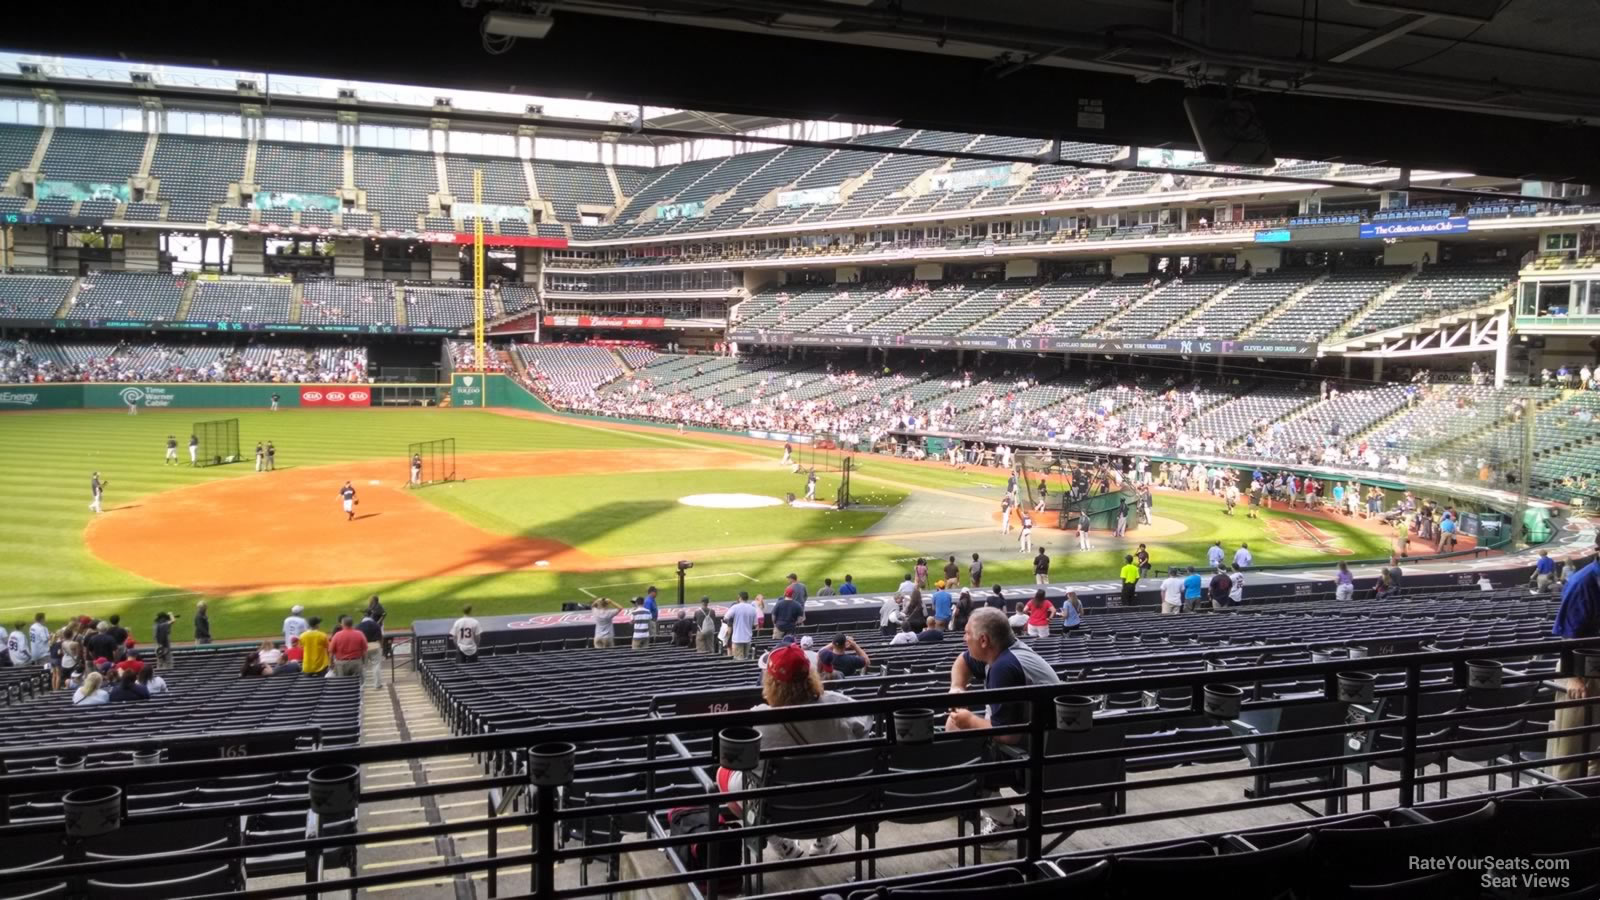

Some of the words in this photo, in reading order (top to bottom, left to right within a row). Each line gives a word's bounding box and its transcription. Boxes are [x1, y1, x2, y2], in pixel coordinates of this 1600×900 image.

[1375, 225, 1387, 235] The
[1388, 224, 1420, 233] Collection
[232, 322, 242, 330] VS
[1021, 339, 1032, 348] VS
[1180, 340, 1193, 353] NY
[1199, 342, 1211, 352] VS
[460, 628, 472, 639] 13
[708, 703, 729, 714] 164
[219, 744, 247, 759] 165
